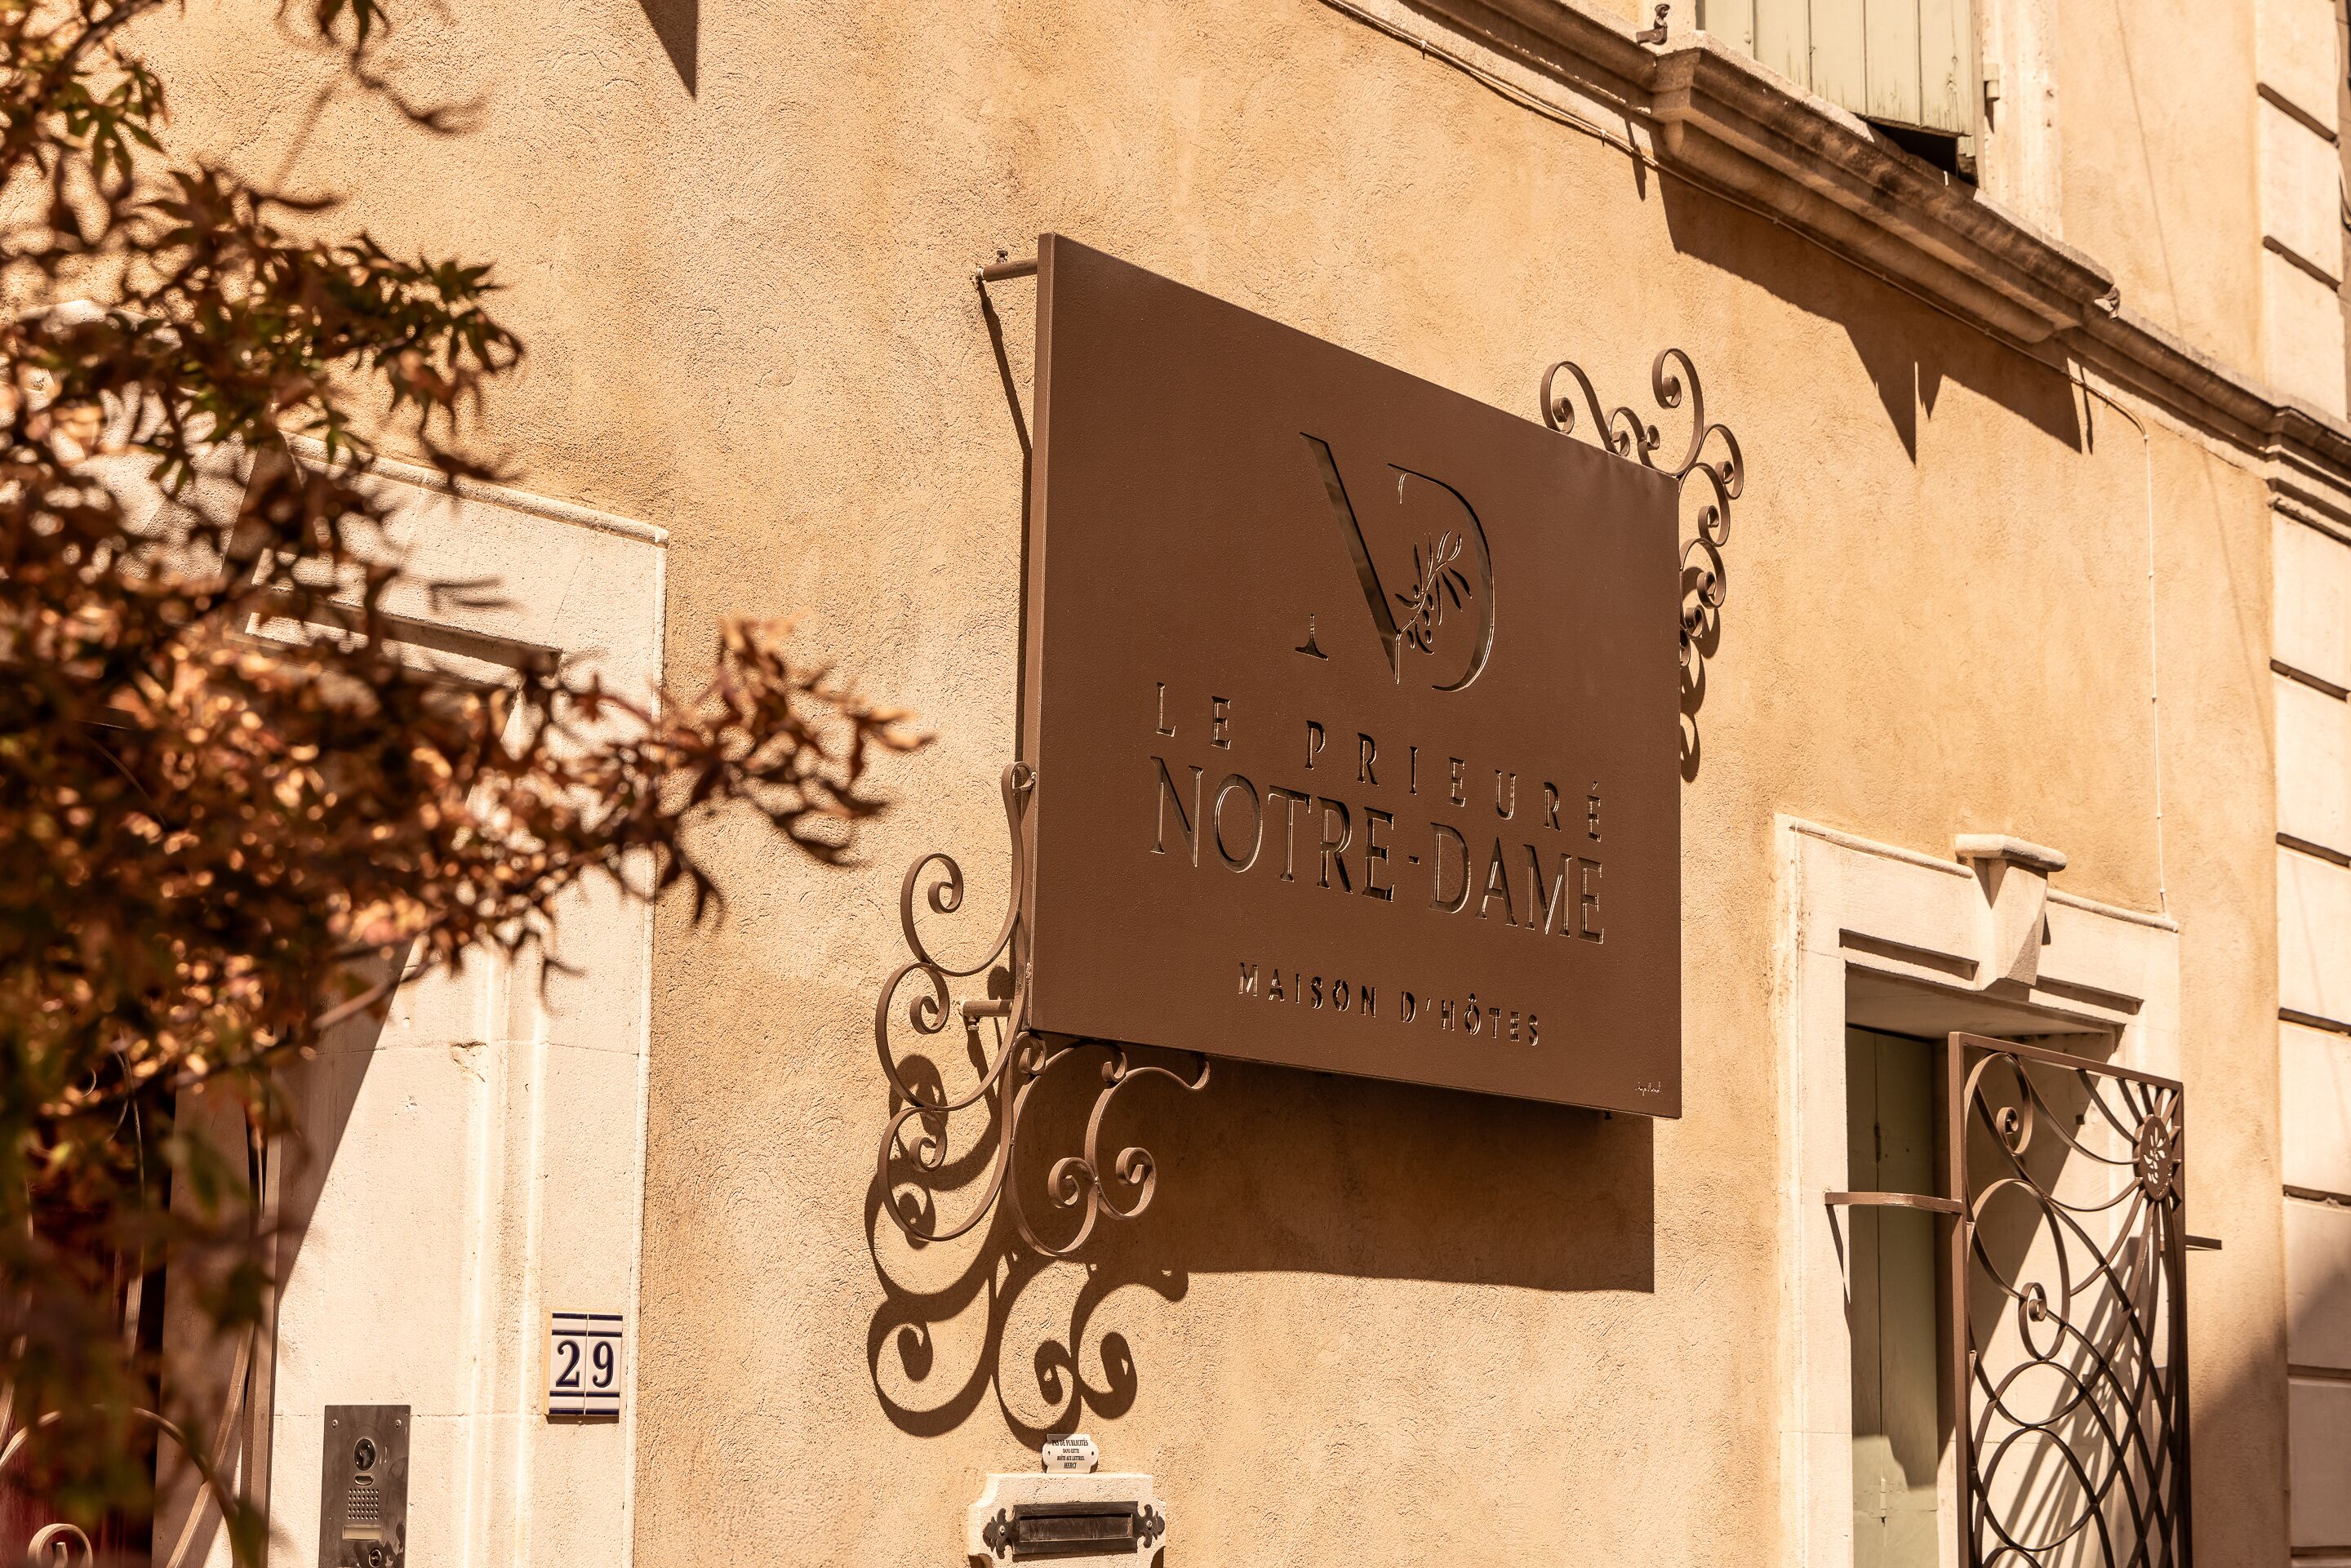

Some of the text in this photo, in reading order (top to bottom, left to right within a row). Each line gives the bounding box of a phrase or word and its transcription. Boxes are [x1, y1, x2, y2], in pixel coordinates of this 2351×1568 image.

[1156, 682, 1602, 842] LE PRIEURÉ
[1150, 756, 1604, 944] NOTRE-DAME
[1238, 962, 1540, 1047] MAISON D'HÔTES
[555, 1339, 615, 1388] 29
